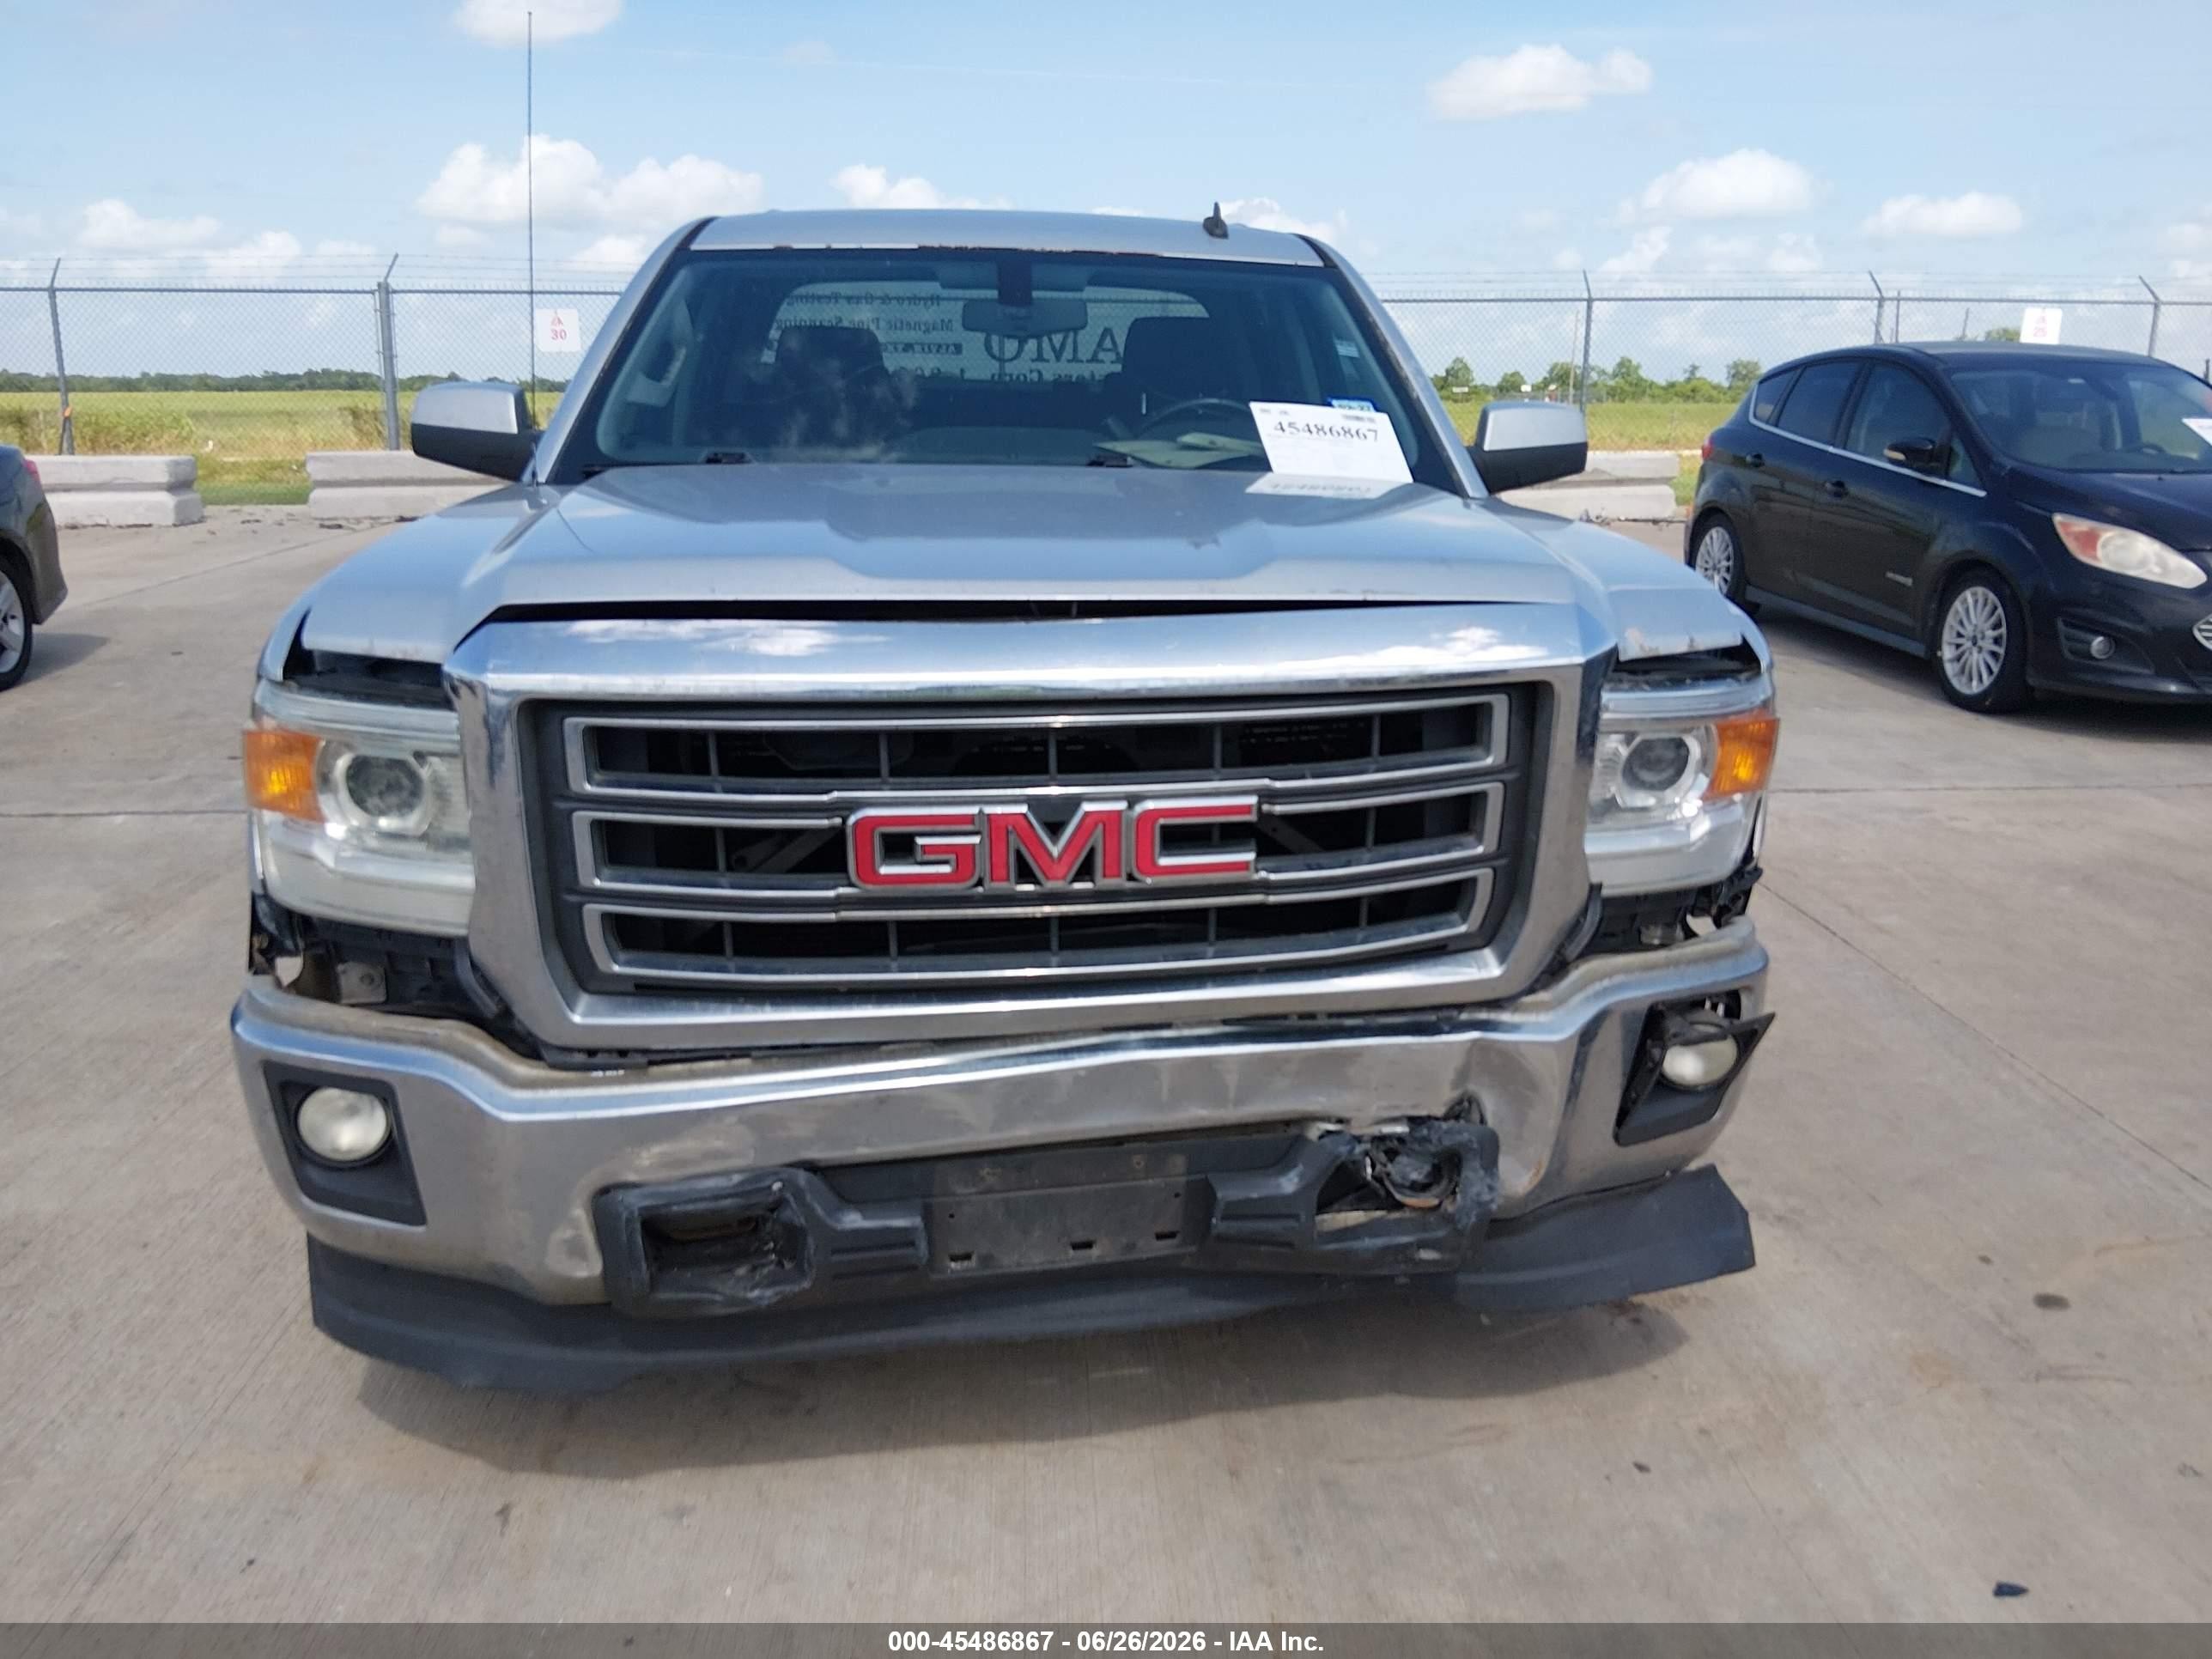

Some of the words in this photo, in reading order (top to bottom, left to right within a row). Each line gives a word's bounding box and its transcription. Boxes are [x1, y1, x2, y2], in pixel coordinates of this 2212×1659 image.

[550, 329, 568, 341] 30
[1274, 421, 1378, 442] 45486867
[846, 794, 1259, 890] GMC
